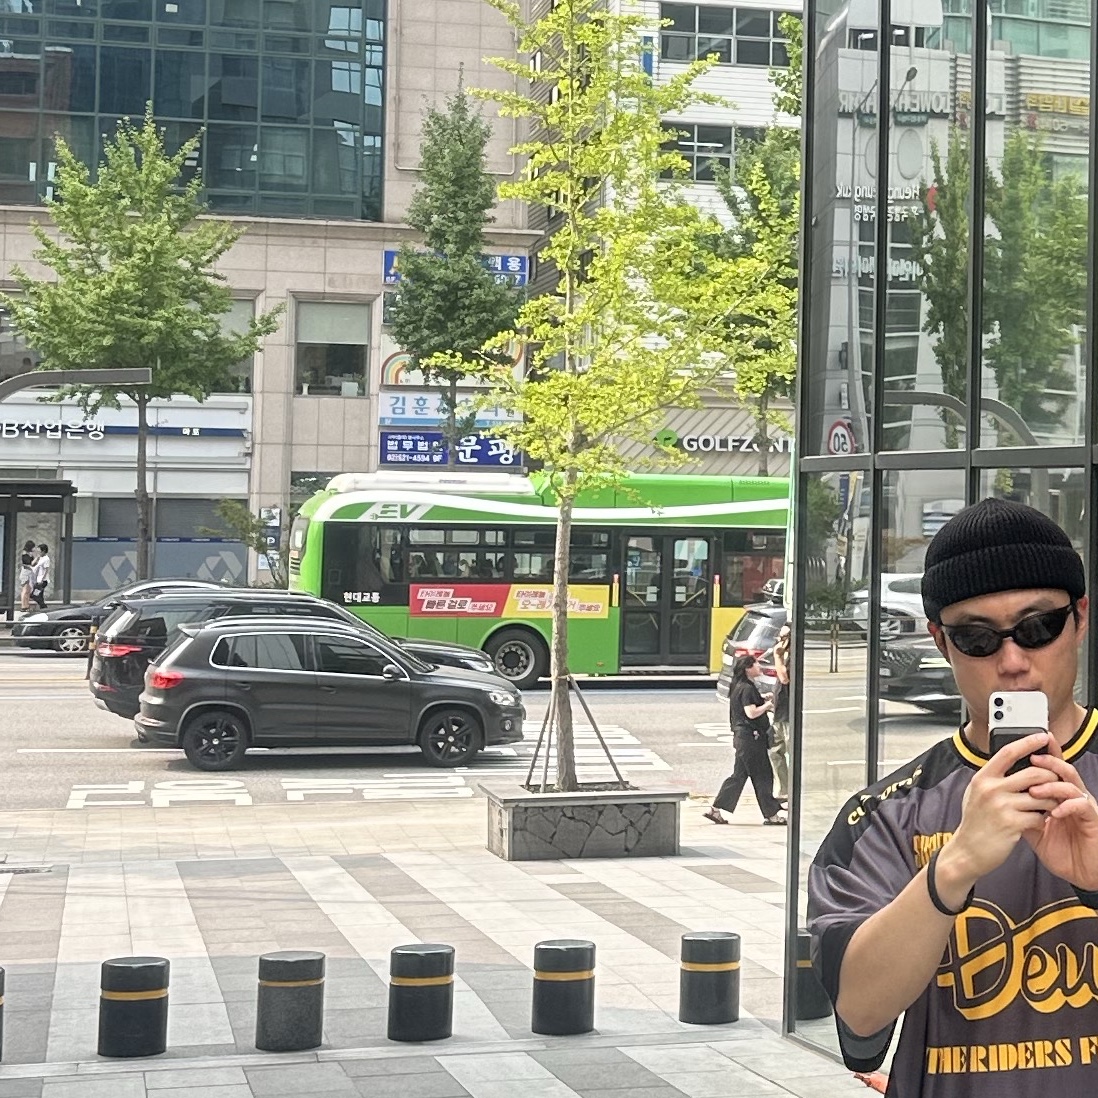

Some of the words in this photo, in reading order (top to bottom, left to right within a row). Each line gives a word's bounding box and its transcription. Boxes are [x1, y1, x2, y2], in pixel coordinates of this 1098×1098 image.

[0, 419, 105, 440] B산업은행
[376, 503, 421, 519] EV
[969, 1037, 1073, 1073] RIDERS
